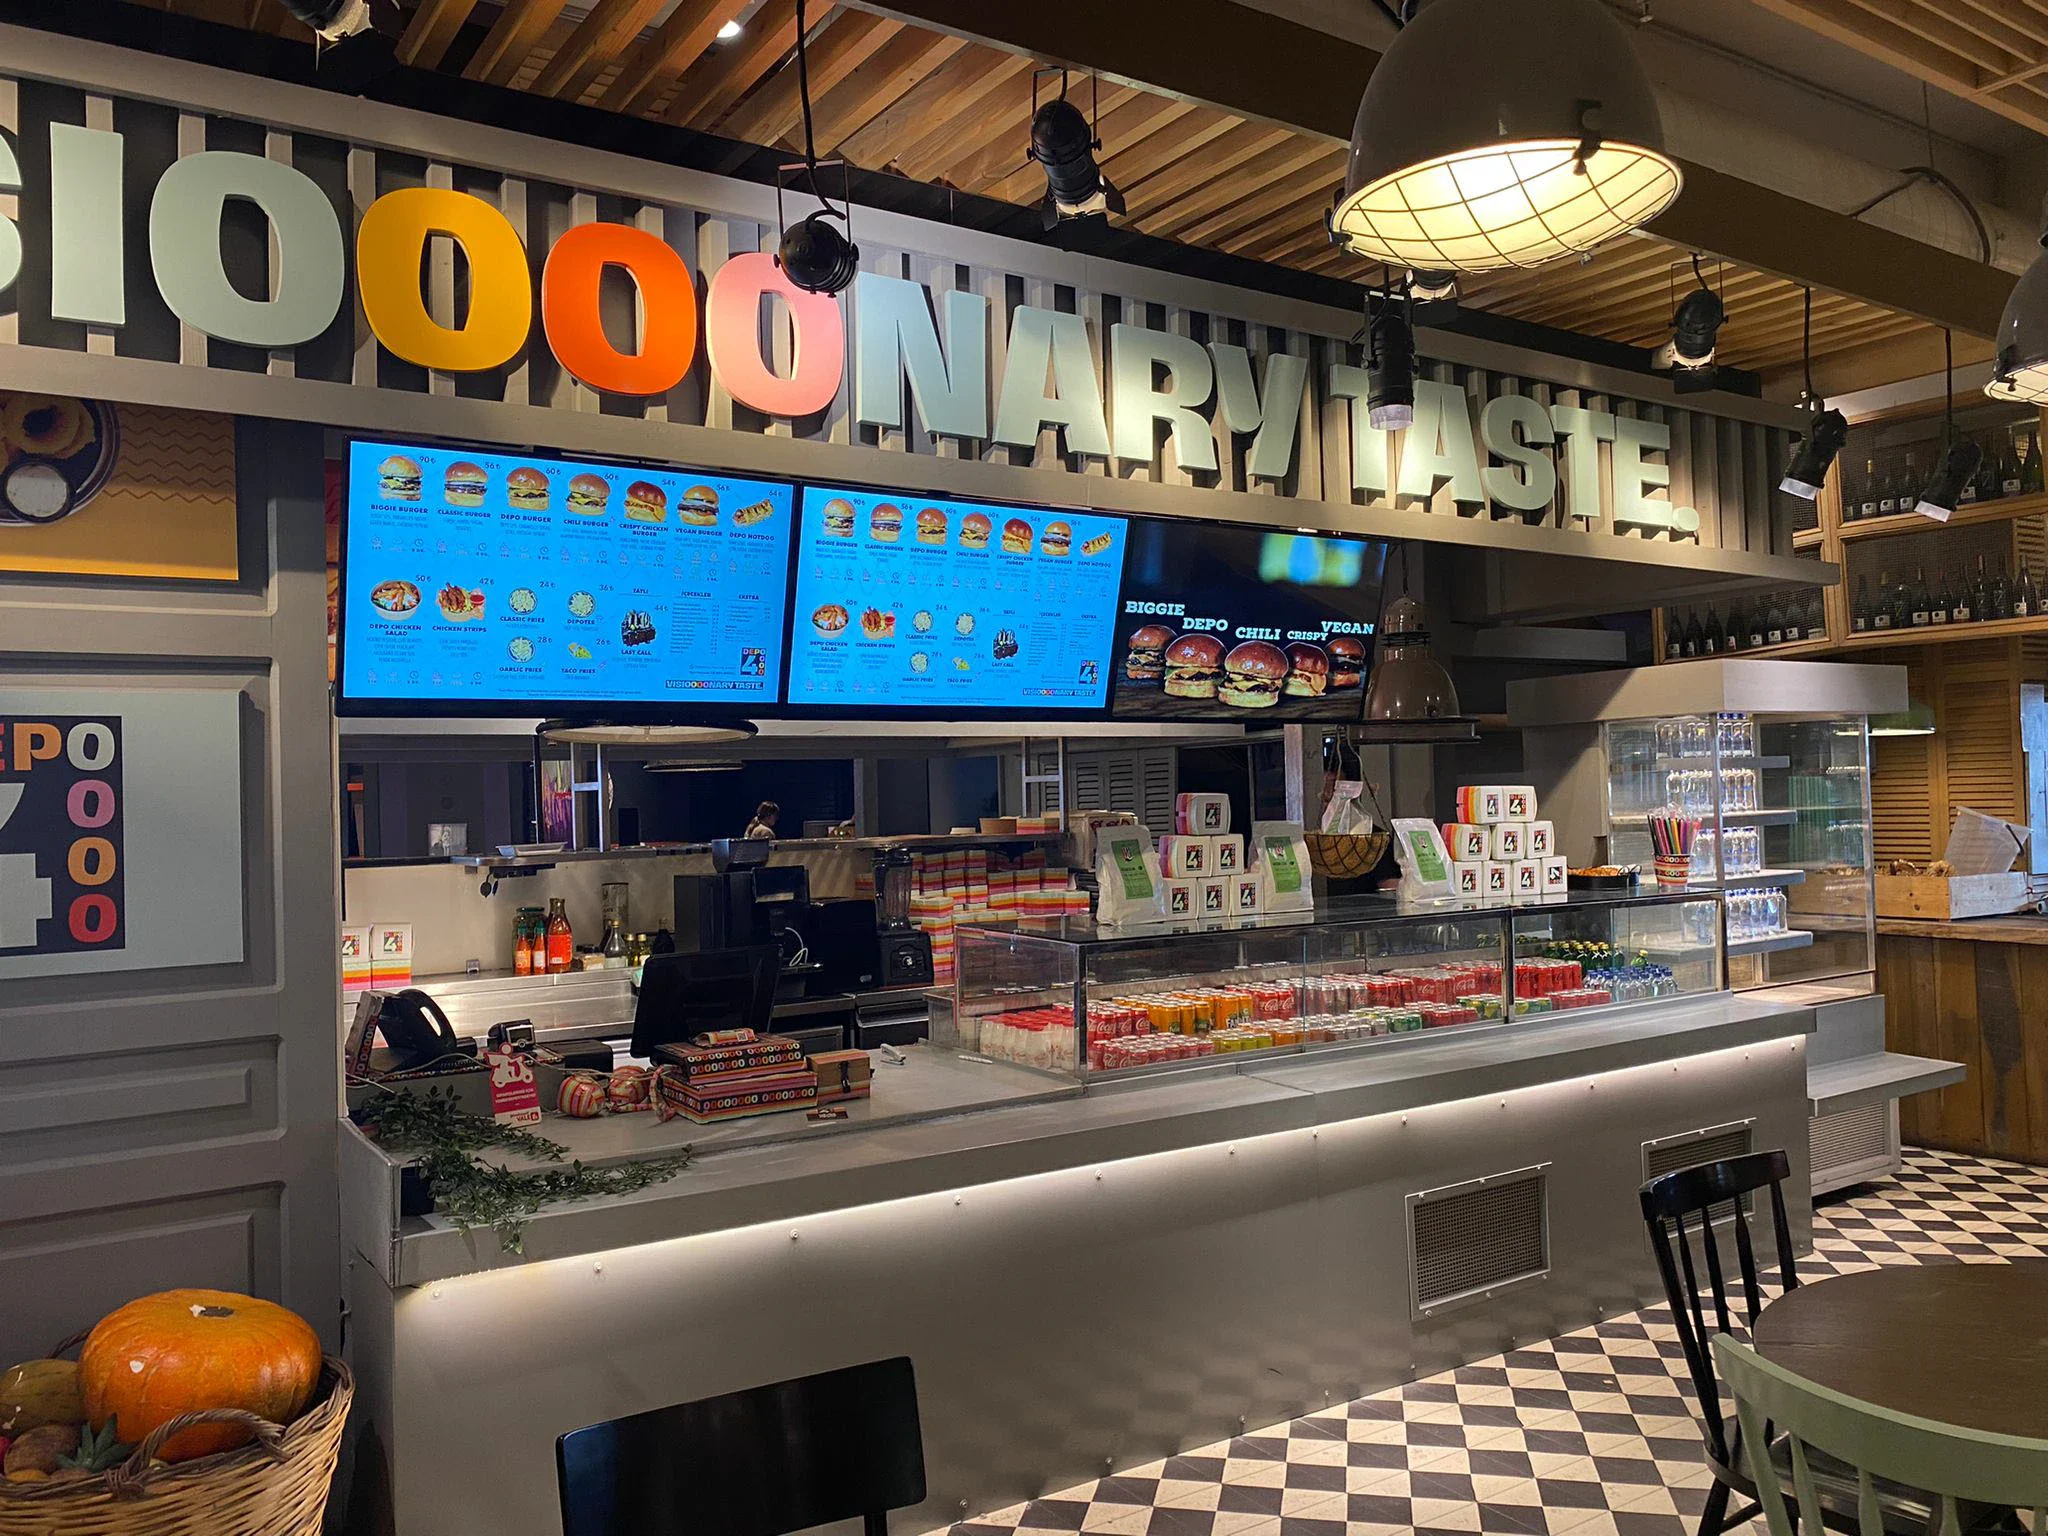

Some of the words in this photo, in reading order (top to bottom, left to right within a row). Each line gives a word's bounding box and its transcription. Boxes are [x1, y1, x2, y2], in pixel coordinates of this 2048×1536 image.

[371, 504, 397, 512] BIGGIE
[398, 506, 428, 514] BURGER
[1125, 601, 1185, 616] BIGGIE
[1182, 618, 1228, 632] DEPO
[1321, 621, 1374, 635] VEGAN
[1235, 626, 1282, 640] CHILI
[1287, 631, 1328, 642] CRISPY
[742, 656, 758, 675] 4
